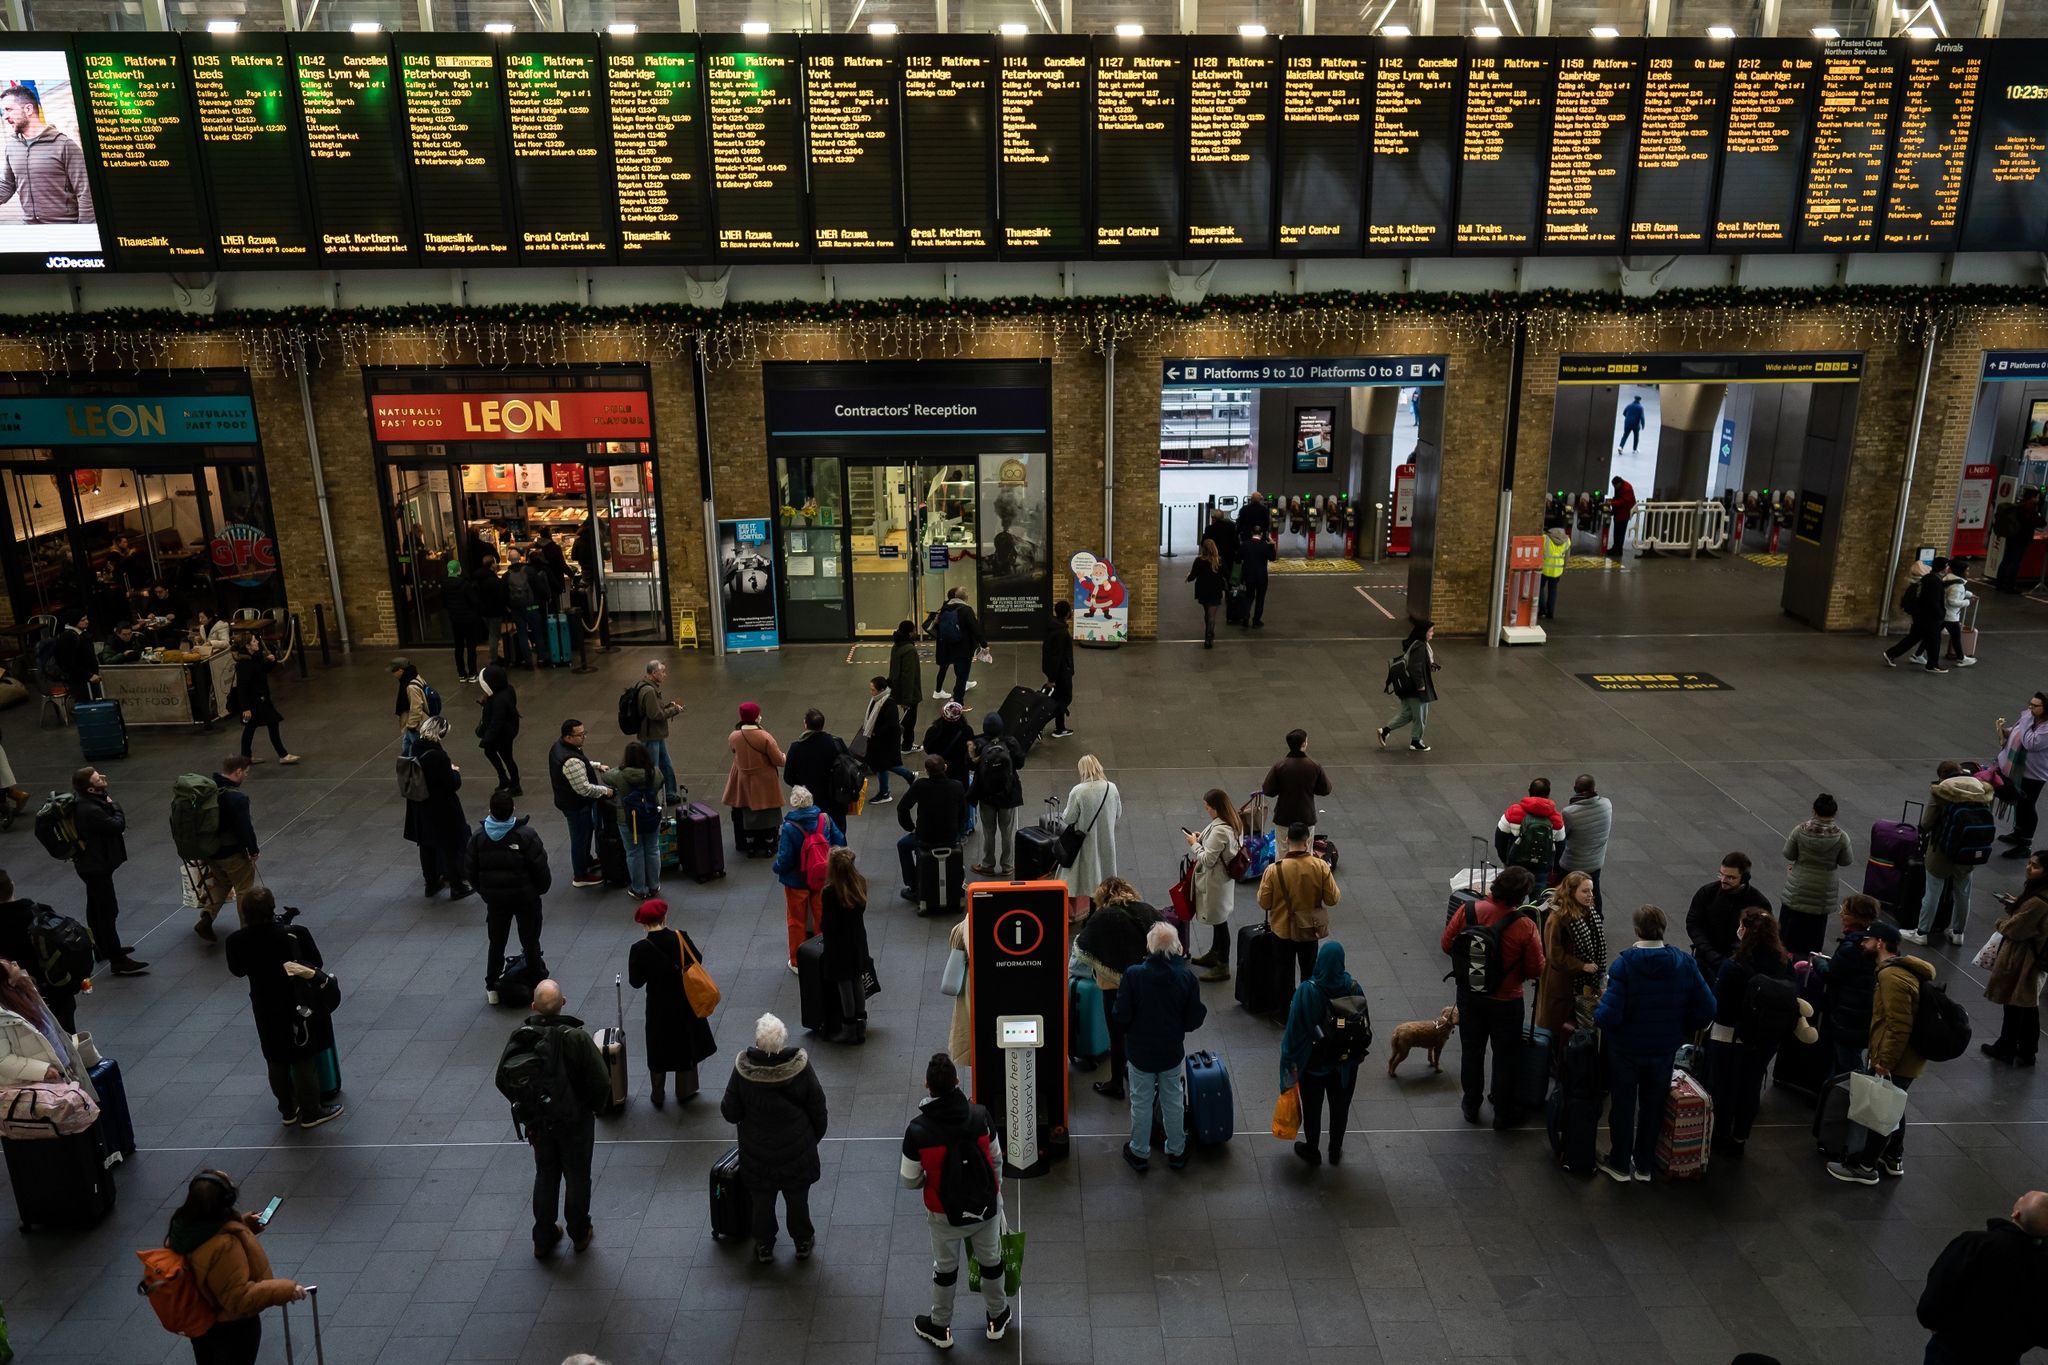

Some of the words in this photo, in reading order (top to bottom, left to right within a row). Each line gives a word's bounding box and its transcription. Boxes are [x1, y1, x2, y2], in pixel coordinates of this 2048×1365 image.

[1824, 48, 1851, 56] Northern
[1854, 48, 1876, 56] Service
[1879, 48, 1887, 56] to:
[1936, 44, 1964, 52] Arrivals
[86, 56, 112, 66] 10:28
[124, 56, 166, 66] Platform
[170, 56, 176, 66] 7
[192, 56, 220, 66] 10:35
[231, 56, 273, 66] Platform
[277, 56, 283, 66] 2
[298, 56, 325, 66] 10:42
[344, 56, 387, 66] Cancelled
[404, 56, 430, 66] 10:46
[437, 56, 449, 66] St
[452, 56, 492, 66] Pancras
[507, 56, 532, 66] 10:48
[544, 56, 583, 66] Platform
[608, 56, 634, 66] 10:58
[645, 56, 684, 66] Platform
[710, 56, 735, 66] 11:00
[746, 56, 784, 66] Platform
[809, 56, 834, 66] 11:06
[844, 56, 882, 66] Platform
[906, 57, 932, 66] 11:12
[942, 57, 980, 66] Platform
[1003, 58, 1028, 66] 11:14
[1044, 57, 1085, 66] Cancelled
[1099, 58, 1124, 66] 11:27
[1134, 58, 1171, 66] Platform
[1193, 58, 1218, 67] 11:28
[1227, 58, 1264, 67] Platform
[1288, 58, 1311, 67] 11:33
[1321, 58, 1358, 68] Platform
[1379, 58, 1402, 68] 11:42
[1418, 58, 1457, 68] Cancelled
[1471, 59, 1494, 68] 11:48
[1504, 59, 1540, 68] Platform
[1561, 59, 1584, 68] 11:58
[1593, 59, 1628, 68] Platform
[1650, 60, 1672, 68] 12:03
[1695, 60, 1708, 68] On
[1712, 60, 1725, 68] time
[1738, 60, 1760, 68] 12:12
[1782, 60, 1796, 68] On
[1799, 60, 1812, 68] time
[87, 70, 144, 80] Letchworth
[194, 70, 223, 79] Leeds
[299, 70, 326, 80] Kings
[329, 70, 352, 80] Lynn
[356, 69, 370, 78] via
[404, 70, 470, 80] Peterborough
[507, 69, 548, 78] Bradford
[555, 70, 588, 78] Interch
[609, 69, 655, 79] Cambridge
[709, 69, 754, 79] Edinburgh
[808, 70, 830, 78] York
[906, 70, 951, 80] Cambridge
[1002, 70, 1064, 80] Peterborough
[1098, 70, 1158, 79] Northallerton
[1192, 70, 1242, 80] Letchworth
[1286, 70, 1324, 80] Wakefield
[1327, 70, 1364, 80] Kirkgate
[1378, 71, 1400, 80] Kings
[1403, 71, 1424, 80] Lynn
[1431, 71, 1439, 80] via
[1470, 72, 1484, 80] Hull
[1487, 72, 1499, 80] via
[1559, 72, 1600, 82] Cambridge
[1648, 72, 1672, 80] Leeds
[1736, 72, 1747, 80] via
[1750, 72, 1790, 82] Cambridge
[89, 82, 110, 90] Calling
[139, 82, 154, 90] Page
[196, 82, 223, 90] Boarding
[1006, 228, 1051, 237] Thameslink
[1098, 228, 1124, 236] Grand
[1127, 228, 1158, 236] Central
[1190, 226, 1234, 236] Thameslink
[1632, 224, 1651, 232] LNER
[1654, 224, 1678, 232] Azuma
[324, 234, 351, 243] Great
[355, 234, 398, 242] Northern
[424, 234, 473, 242] Thameslink
[524, 232, 552, 242] Grand
[556, 232, 589, 242] Central
[623, 231, 670, 240] Thameslink
[720, 230, 742, 239] LNER
[745, 230, 772, 239] Azuma
[816, 230, 838, 238] LNER
[841, 230, 868, 238] Azuma
[118, 237, 168, 246] Thameslink
[221, 236, 244, 245] LNER
[248, 236, 276, 245] Azuma
[46, 256, 104, 268] JCDecaux
[1593, 366, 1606, 374] gate
[1799, 364, 1813, 372] gate
[2010, 362, 2040, 370] Platforms
[1204, 367, 1259, 379] Platforms
[1262, 368, 1270, 378] 9
[1273, 368, 1286, 378] to
[1290, 367, 1304, 378] 10
[1310, 367, 1365, 378] Platforms
[1369, 366, 1376, 377] 0
[1380, 367, 1392, 377] to
[1396, 365, 1403, 376] 8
[183, 408, 247, 418] NATURALLY
[379, 408, 441, 416] NATURALLY
[835, 404, 912, 416] Contractors'
[914, 404, 977, 418] Reception
[66, 405, 167, 437] LEON
[463, 400, 561, 433] LEON
[594, 416, 644, 425] FLAVOUR
[186, 421, 211, 430] FAST
[217, 421, 248, 430] FOOD
[382, 420, 406, 428] FAST
[1969, 466, 1990, 474] LNER
[210, 538, 276, 567] GFC
[119, 684, 169, 695] Naturally
[119, 698, 140, 706] AST
[146, 697, 179, 705] FOOD
[1010, 1051, 1019, 1080] here
[1025, 1050, 1034, 1080] here
[1011, 1081, 1020, 1142] feedback
[1025, 1081, 1033, 1142] feedback
